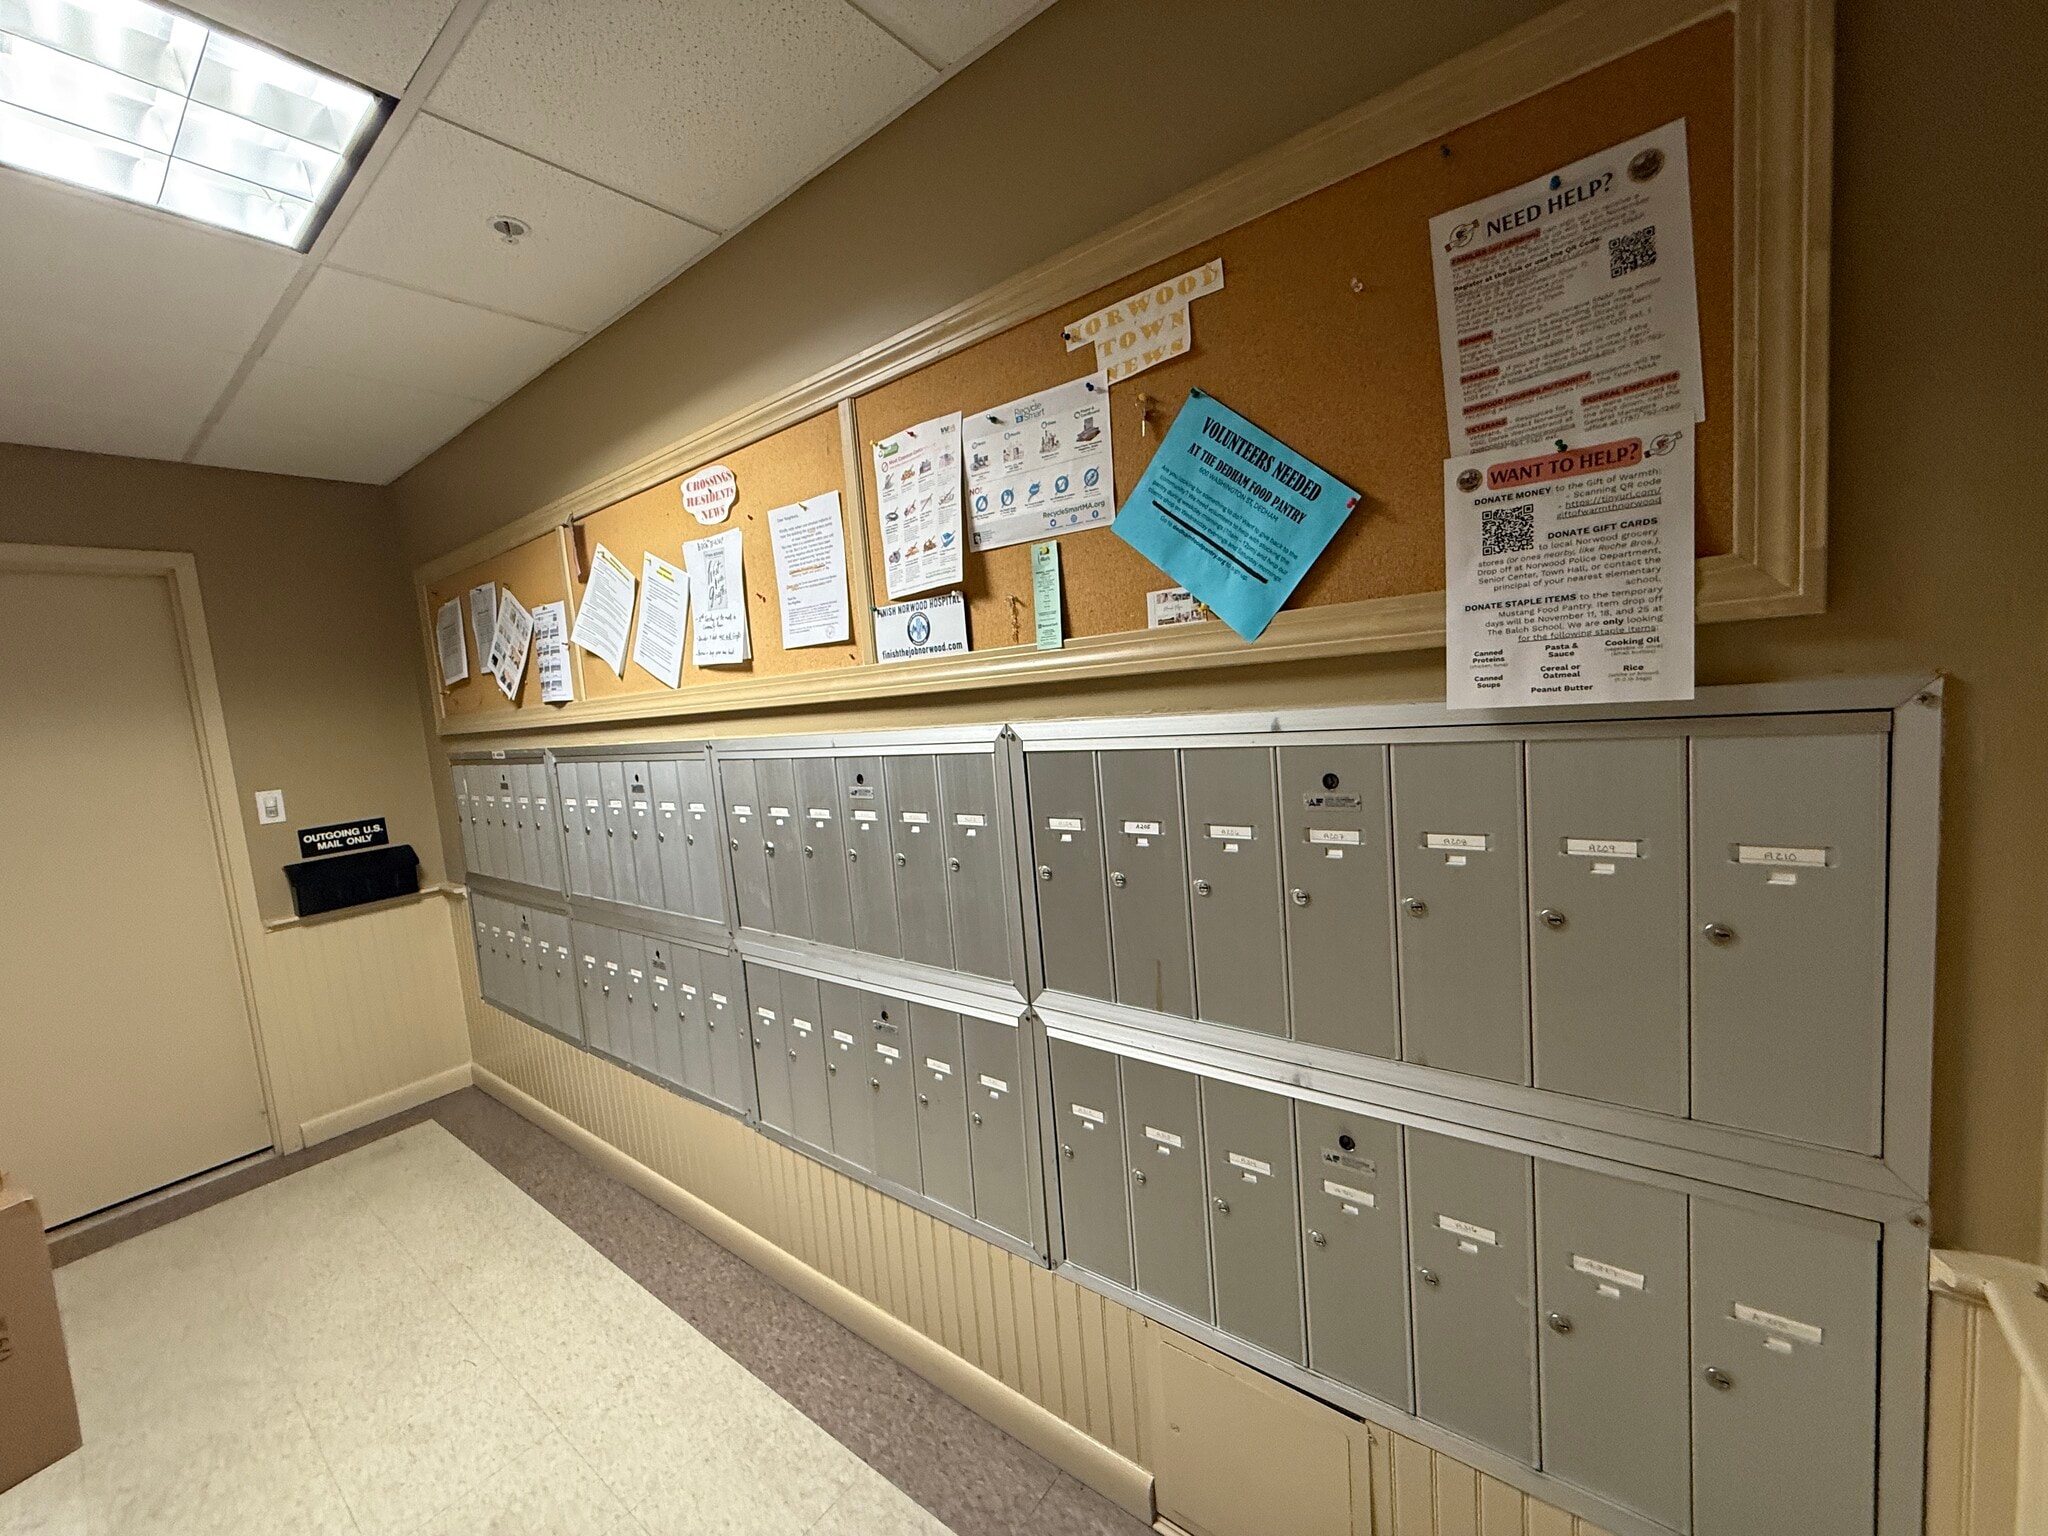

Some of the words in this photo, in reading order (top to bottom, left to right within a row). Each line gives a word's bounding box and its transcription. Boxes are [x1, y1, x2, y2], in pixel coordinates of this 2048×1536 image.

[1487, 204, 1541, 237] NEED
[1548, 172, 1613, 214] HELP?
[1550, 250, 1563, 259] the
[1565, 244, 1577, 253] QR
[1098, 309, 1185, 357] TOWN
[1464, 399, 1501, 415] NORWOOD
[1503, 386, 1541, 404] HOUSING
[1543, 372, 1591, 393] AUTHORITY
[1014, 402, 1042, 416] Recycle
[1467, 418, 1507, 434] VETERANS
[1202, 416, 1275, 473] VOLUNTEERS
[1271, 461, 1322, 502] NEEDED
[1490, 462, 1544, 485] WANT
[1549, 457, 1574, 474] TO
[1580, 442, 1638, 469] HELP?
[686, 472, 733, 492] CROSSINGS
[1187, 442, 1202, 457] AT
[1199, 449, 1218, 468] THE
[1214, 459, 1251, 489] DEDHAM
[1247, 481, 1273, 503] FOOD
[1270, 495, 1307, 525] PANTRY
[1474, 493, 1513, 506] DONATE
[1515, 486, 1551, 499] MONEY
[1568, 482, 1583, 490] the
[1586, 478, 1603, 487] Gift
[1606, 475, 1616, 483] of
[1573, 485, 1616, 498] Scanning
[1619, 482, 1634, 491] QR
[1637, 477, 1661, 487] code
[687, 487, 734, 507] RESIDENTS
[1209, 473, 1246, 501] WASHINGTON
[1253, 502, 1278, 522] DEDHAM
[1565, 486, 1661, 509] https://tinyurl.com/
[701, 506, 725, 519] NEWS
[1043, 500, 1106, 519] RecycleSmartMA.org
[1556, 496, 1661, 520] giftofwarmthnorwood
[1547, 527, 1589, 539] DONATE
[1592, 523, 1616, 533] GIFT
[1620, 517, 1658, 529] CARDS
[1551, 539, 1572, 548] local
[1576, 533, 1617, 545] Norwood
[1621, 528, 1657, 540] grocery
[1478, 559, 1503, 567] stores
[1520, 554, 1540, 562] ones
[1543, 549, 1575, 559] nearby,
[1598, 542, 1626, 551] Roche
[1499, 565, 1511, 573] off
[1526, 559, 1565, 569] Norwood
[1568, 556, 1596, 564] Police
[1600, 547, 1661, 561] Department,
[1478, 576, 1504, 584] Senior
[1507, 572, 1538, 581] Center,
[1541, 569, 1564, 577] Town
[1567, 565, 1587, 573] Hall,
[1604, 559, 1641, 569] contact
[1644, 556, 1661, 564] the
[1493, 581, 1530, 592] principal
[1532, 579, 1542, 587] of
[1544, 577, 1564, 587] your
[1567, 572, 1602, 583] nearest
[1605, 566, 1661, 578] elementary
[1625, 574, 1661, 585] school.
[877, 606, 896, 618] FINISH
[897, 602, 928, 615] NORWOOD
[929, 595, 962, 608] HOSPITAL
[1465, 601, 1503, 612] DONATE
[1505, 597, 1542, 608] STAPLE
[1545, 593, 1576, 603] ITEMS
[1611, 586, 1662, 597] temporary
[1498, 608, 1534, 618] Mustang
[1537, 605, 1559, 613] Food
[1597, 600, 1618, 608] Item
[1622, 597, 1644, 606] drop
[1648, 594, 1662, 603] off
[1485, 620, 1503, 628] days
[1538, 612, 1584, 622] November
[1615, 607, 1634, 615] and
[1505, 626, 1528, 634] Balch
[1532, 622, 1564, 632] School.
[1602, 617, 1623, 626] only
[1626, 614, 1664, 624] looking
[1549, 630, 1593, 640] following
[1595, 627, 1624, 636] staple
[1604, 638, 1644, 647] Cooking
[1646, 635, 1659, 643] Oil
[882, 642, 963, 658] finishthejobnorwood.com
[1472, 656, 1505, 664] Proteins
[1474, 649, 1503, 657] Canned
[1474, 674, 1503, 682] Canned
[1540, 664, 1568, 672] Cereal
[1542, 670, 1581, 679] Oatmeal
[303, 827, 360, 843] OUTGOING
[363, 824, 384, 834] U.S.
[317, 840, 344, 850] MAIL
[346, 834, 372, 845] ONLY
[1443, 838, 1467, 846] A208
[1588, 844, 1615, 853] A209
[1764, 851, 1797, 861] A210
